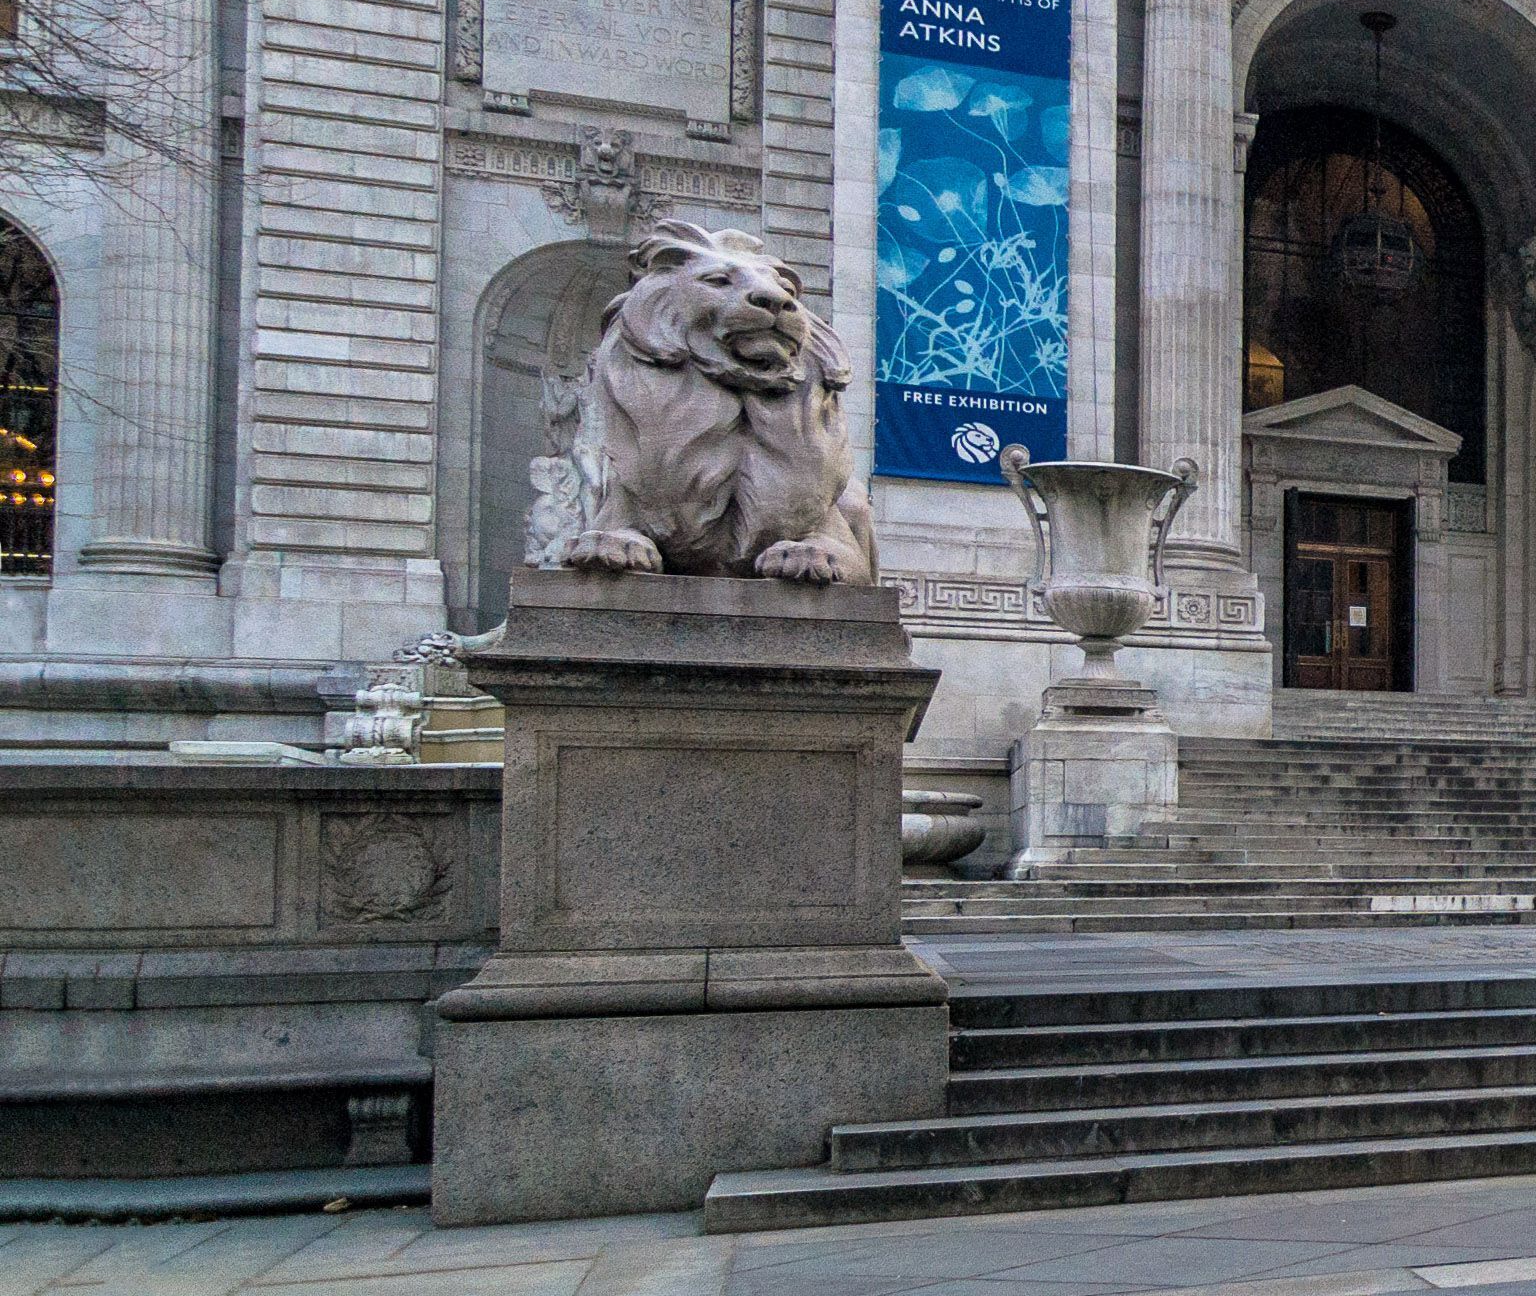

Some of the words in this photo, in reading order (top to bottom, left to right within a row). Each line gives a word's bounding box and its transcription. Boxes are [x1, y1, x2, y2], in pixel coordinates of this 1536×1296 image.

[635, 23, 712, 51] VOICE
[900, 23, 1002, 53] ATKINS
[486, 32, 541, 54] AND
[654, 54, 728, 81] WORD
[902, 391, 943, 408] FREE
[948, 396, 1049, 415] EXHIBITION
